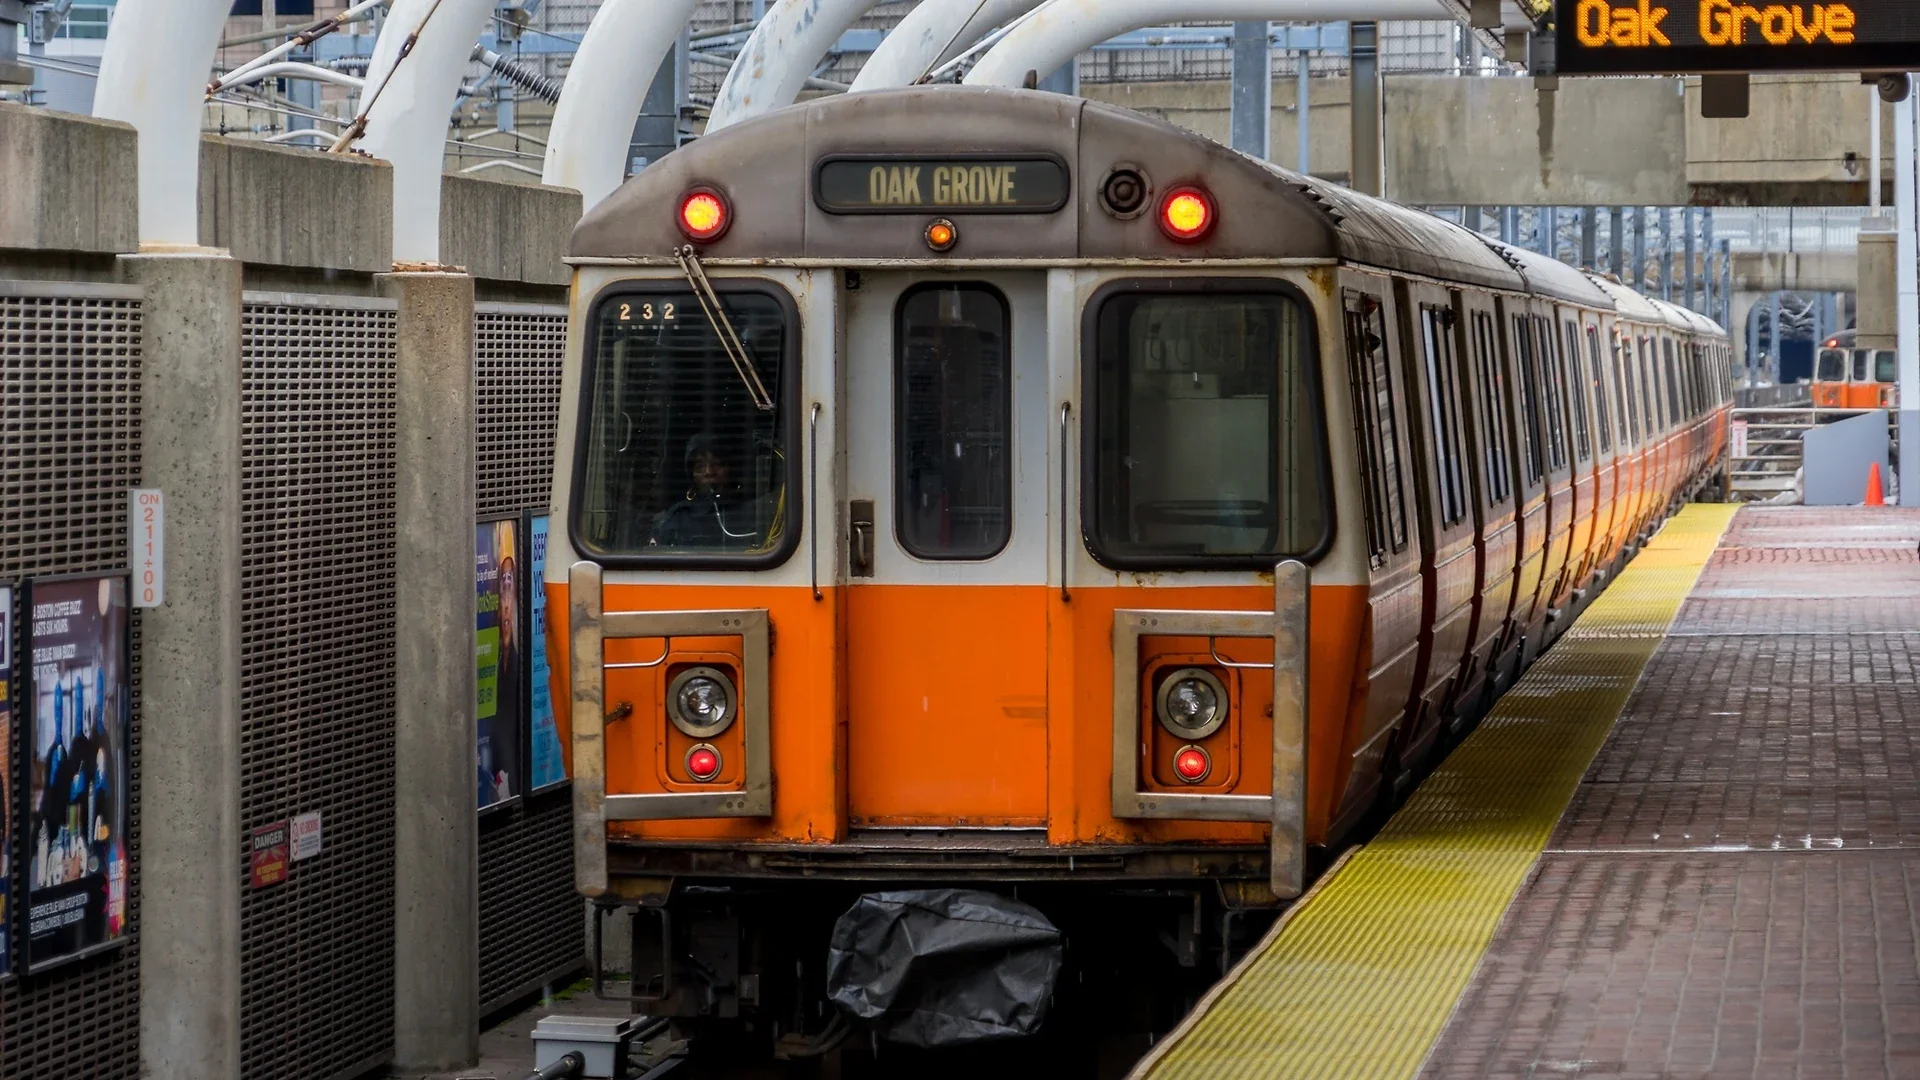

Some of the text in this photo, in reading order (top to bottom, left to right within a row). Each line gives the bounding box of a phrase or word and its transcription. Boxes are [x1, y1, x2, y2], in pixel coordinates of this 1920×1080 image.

[1576, 0, 1855, 47] Oak Grove
[869, 166, 1017, 204] OAK GROVE
[139, 494, 159, 505] ON
[37, 603, 53, 618] BOSTON
[54, 601, 70, 617] COFFEE
[70, 600, 82, 615] BUZZ
[32, 621, 46, 636] LASTS
[32, 649, 41, 664] THE
[41, 647, 52, 662] BLUE
[254, 830, 283, 850] DANGER
